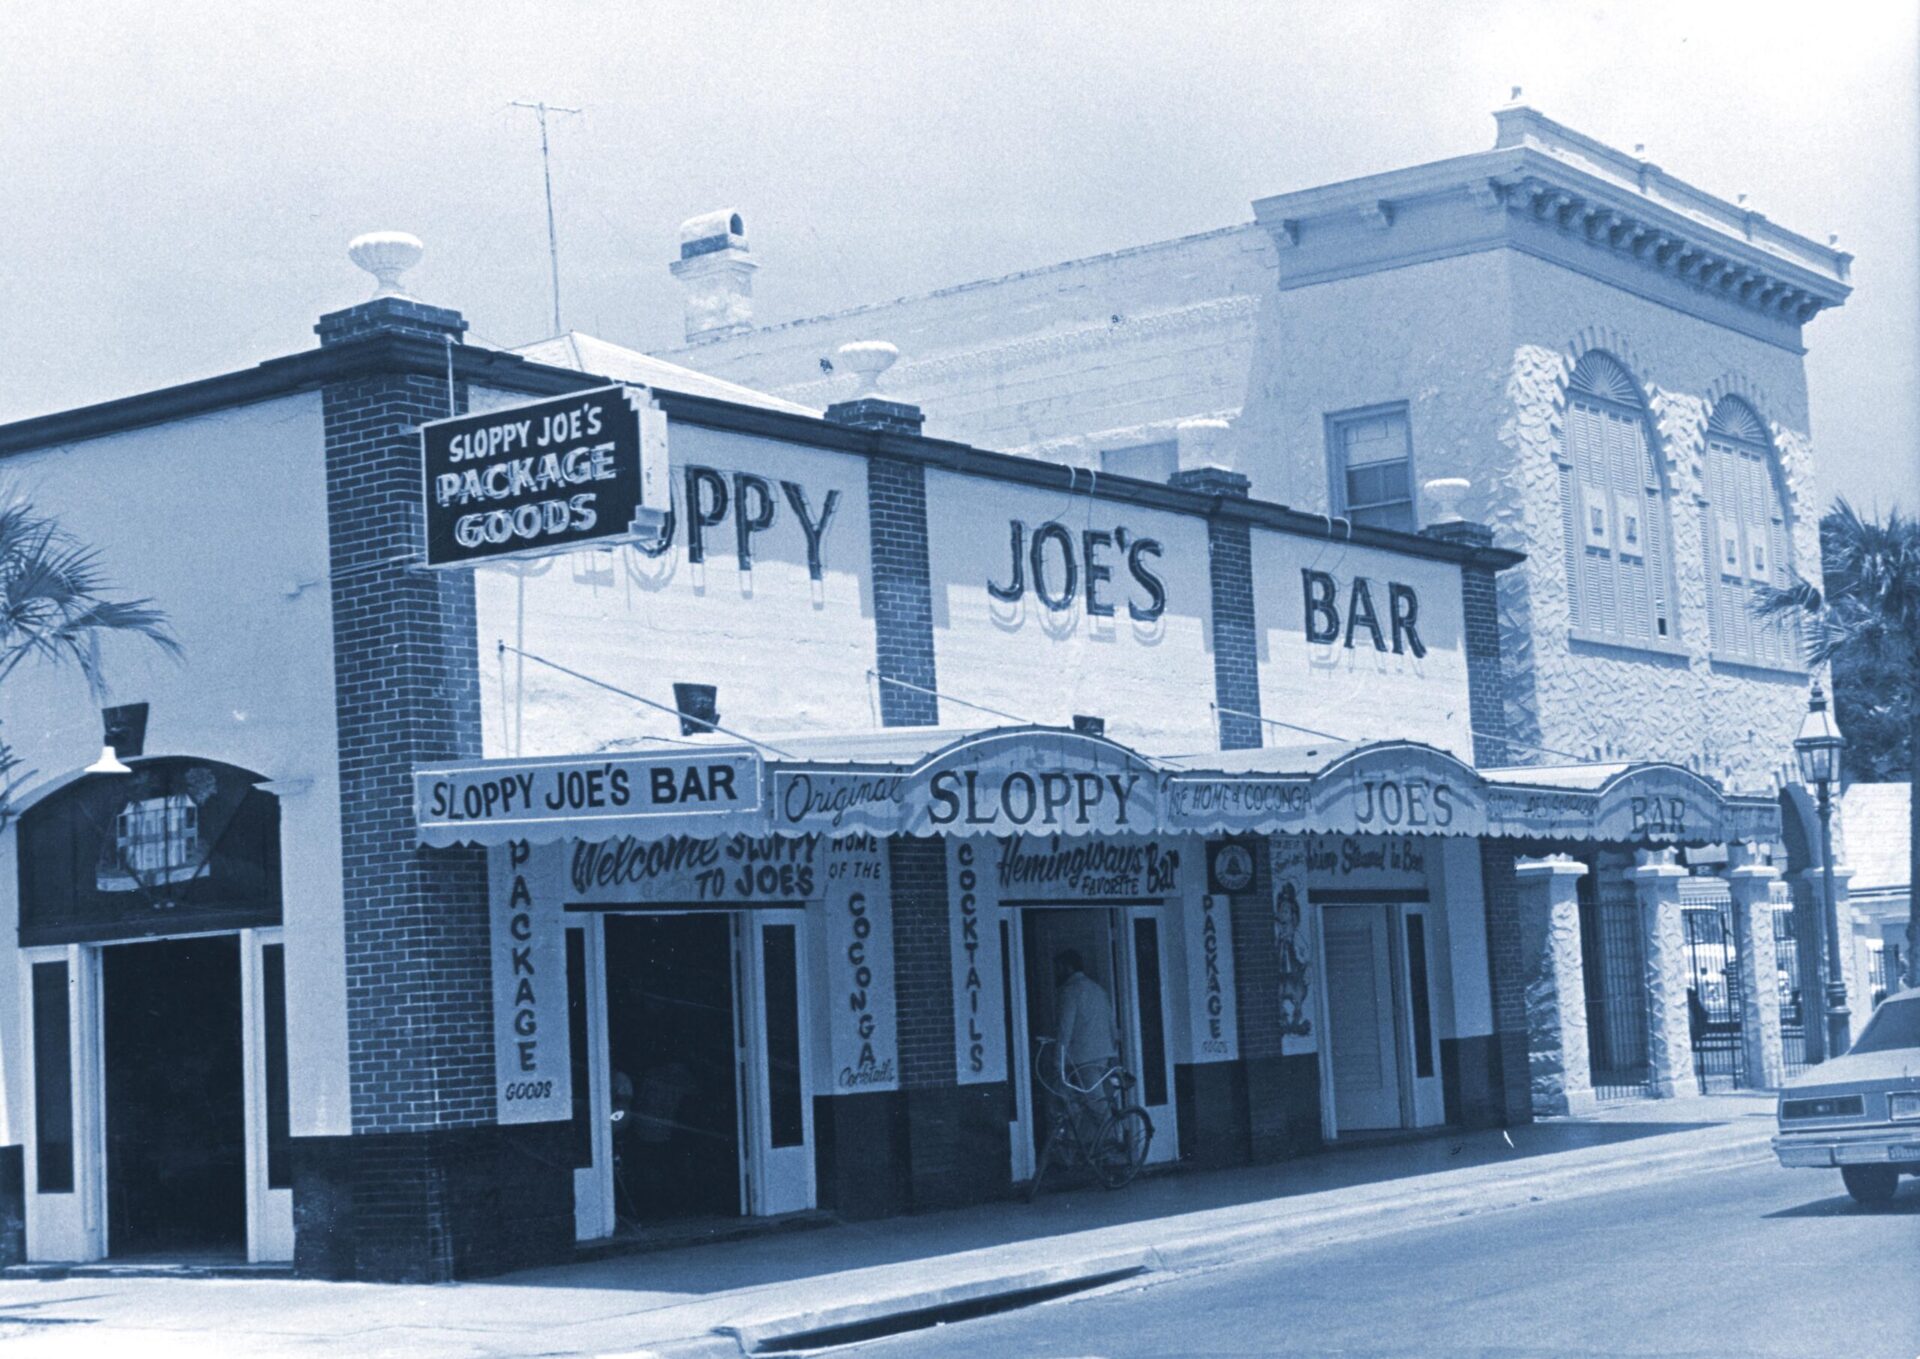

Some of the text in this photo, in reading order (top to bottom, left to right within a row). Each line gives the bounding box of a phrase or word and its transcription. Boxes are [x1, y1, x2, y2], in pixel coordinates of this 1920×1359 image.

[449, 402, 602, 463] SLOPPY JOE'S
[436, 441, 617, 507] PACKAGE
[454, 492, 598, 548] GOODS
[637, 464, 841, 582] PPY
[987, 519, 1166, 621] JOE'S
[1301, 567, 1427, 659] BAR
[430, 763, 738, 819] SLOPPY JOE'S BAR
[785, 767, 904, 827] Original
[927, 769, 1140, 825] SLOPPY
[1192, 783, 1230, 811] HOME
[1244, 784, 1313, 811] COCONGA
[1355, 780, 1453, 827] JOE'S
[1631, 795, 1686, 834] BAR
[571, 834, 720, 894] Welcome
[828, 862, 881, 879] OF THE
[832, 835, 878, 853] HOME
[1145, 842, 1179, 892] Bar
[696, 863, 814, 899] TO JOE'S
[1081, 874, 1140, 896] FAVORITE
[509, 840, 538, 1073] PACKAGE
[848, 893, 876, 1070] COCONGA
[958, 844, 983, 1072] COCKTAILS
[1203, 895, 1222, 1039] PACKAGE
[505, 1080, 553, 1101] GOODS
